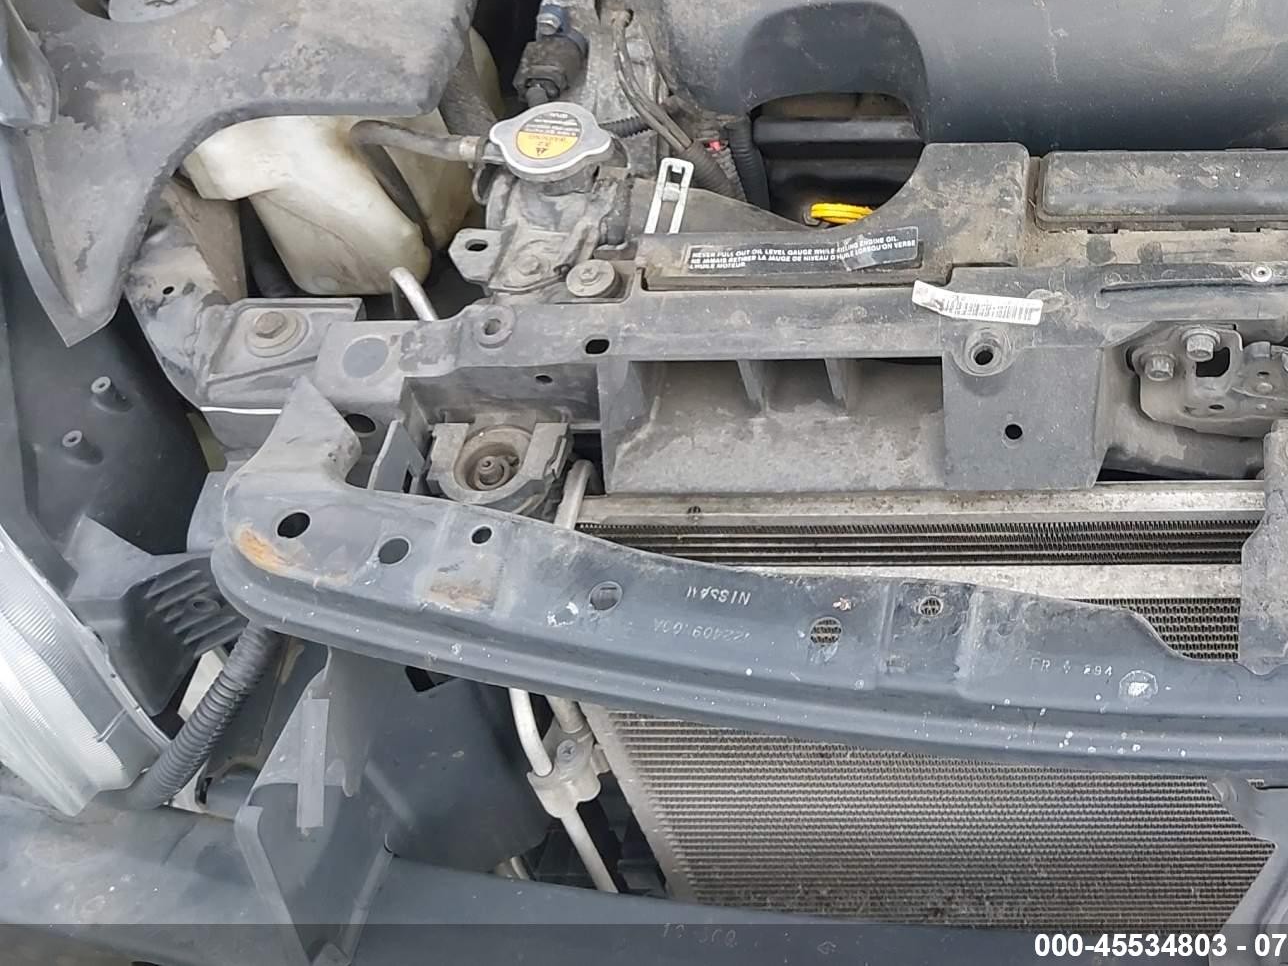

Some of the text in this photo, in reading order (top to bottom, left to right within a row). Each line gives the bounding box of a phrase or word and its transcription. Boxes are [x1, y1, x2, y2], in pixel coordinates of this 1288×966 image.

[735, 249, 750, 257] OUT
[859, 237, 885, 247] ENGINE
[757, 253, 767, 262] LA
[767, 254, 791, 262] JAUGE
[802, 253, 829, 261] NIVEAU
[717, 262, 746, 270] MOTEUR
